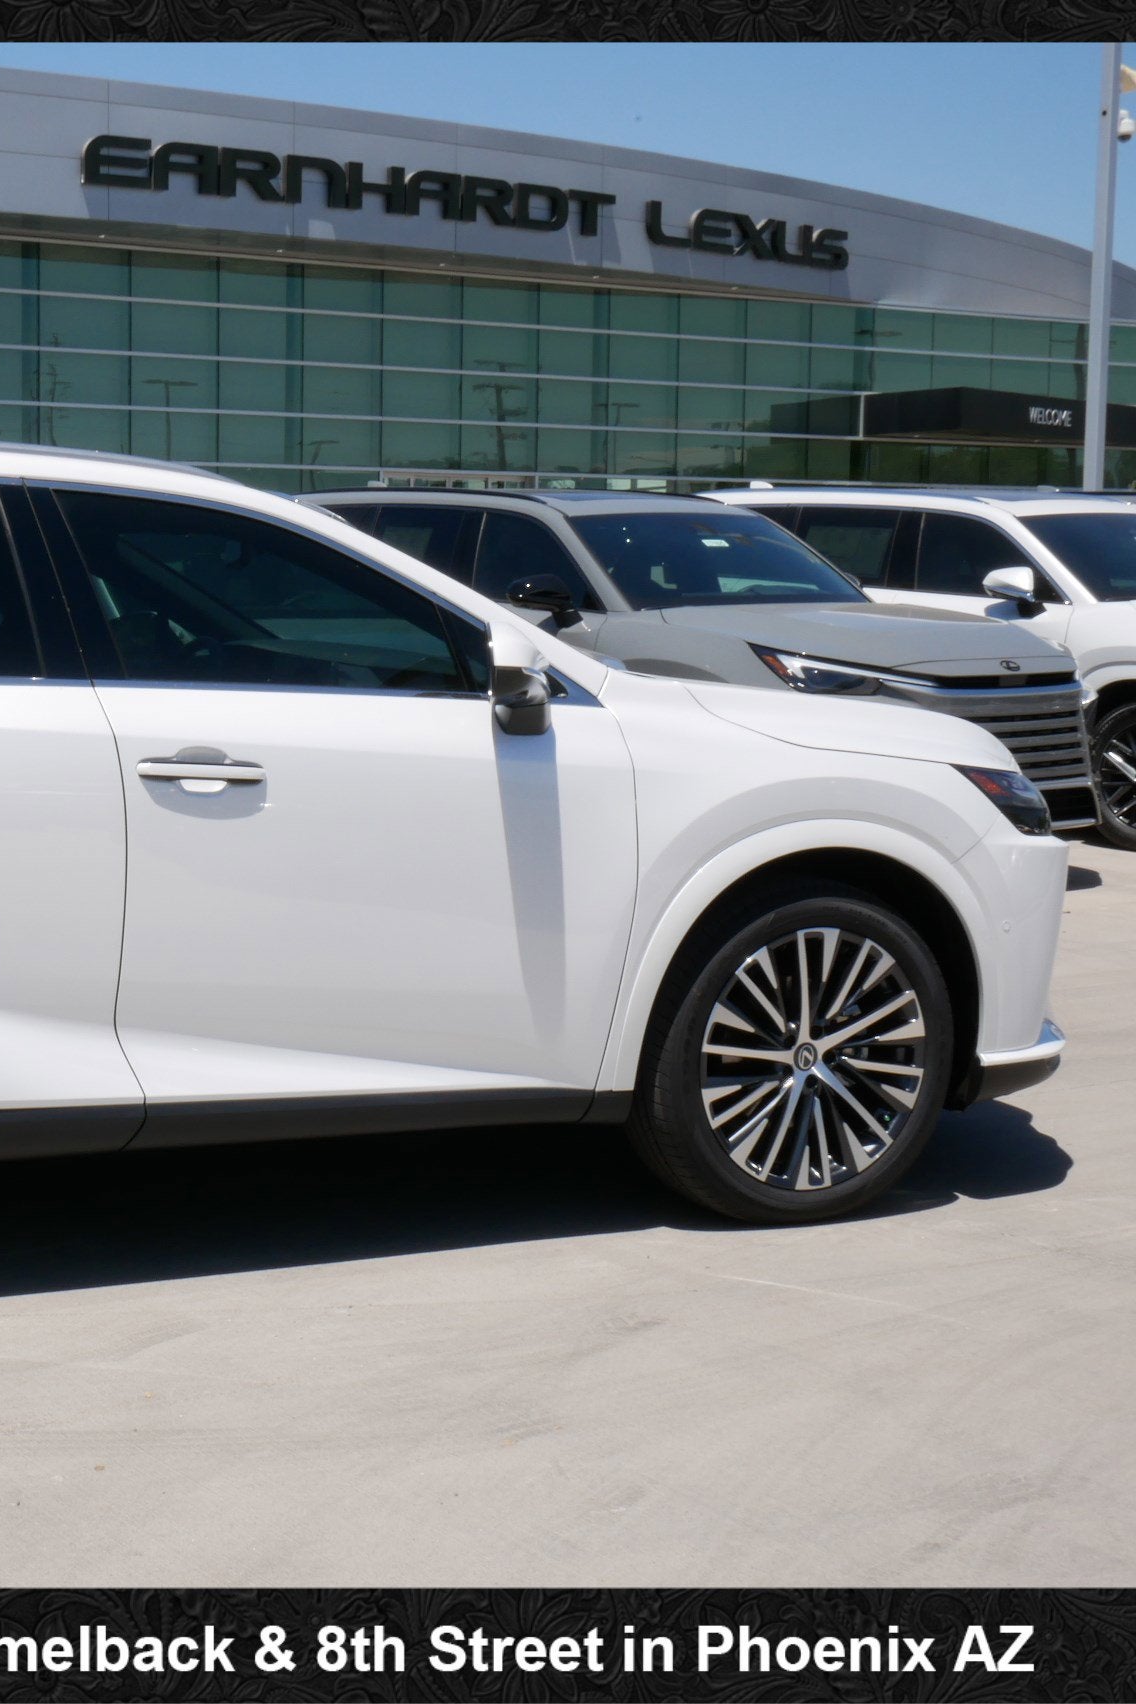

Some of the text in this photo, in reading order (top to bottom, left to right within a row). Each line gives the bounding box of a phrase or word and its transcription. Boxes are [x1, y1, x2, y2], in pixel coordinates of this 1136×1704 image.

[81, 135, 849, 270] EARNHARDT LEXUS
[1029, 406, 1072, 427] WELCOME
